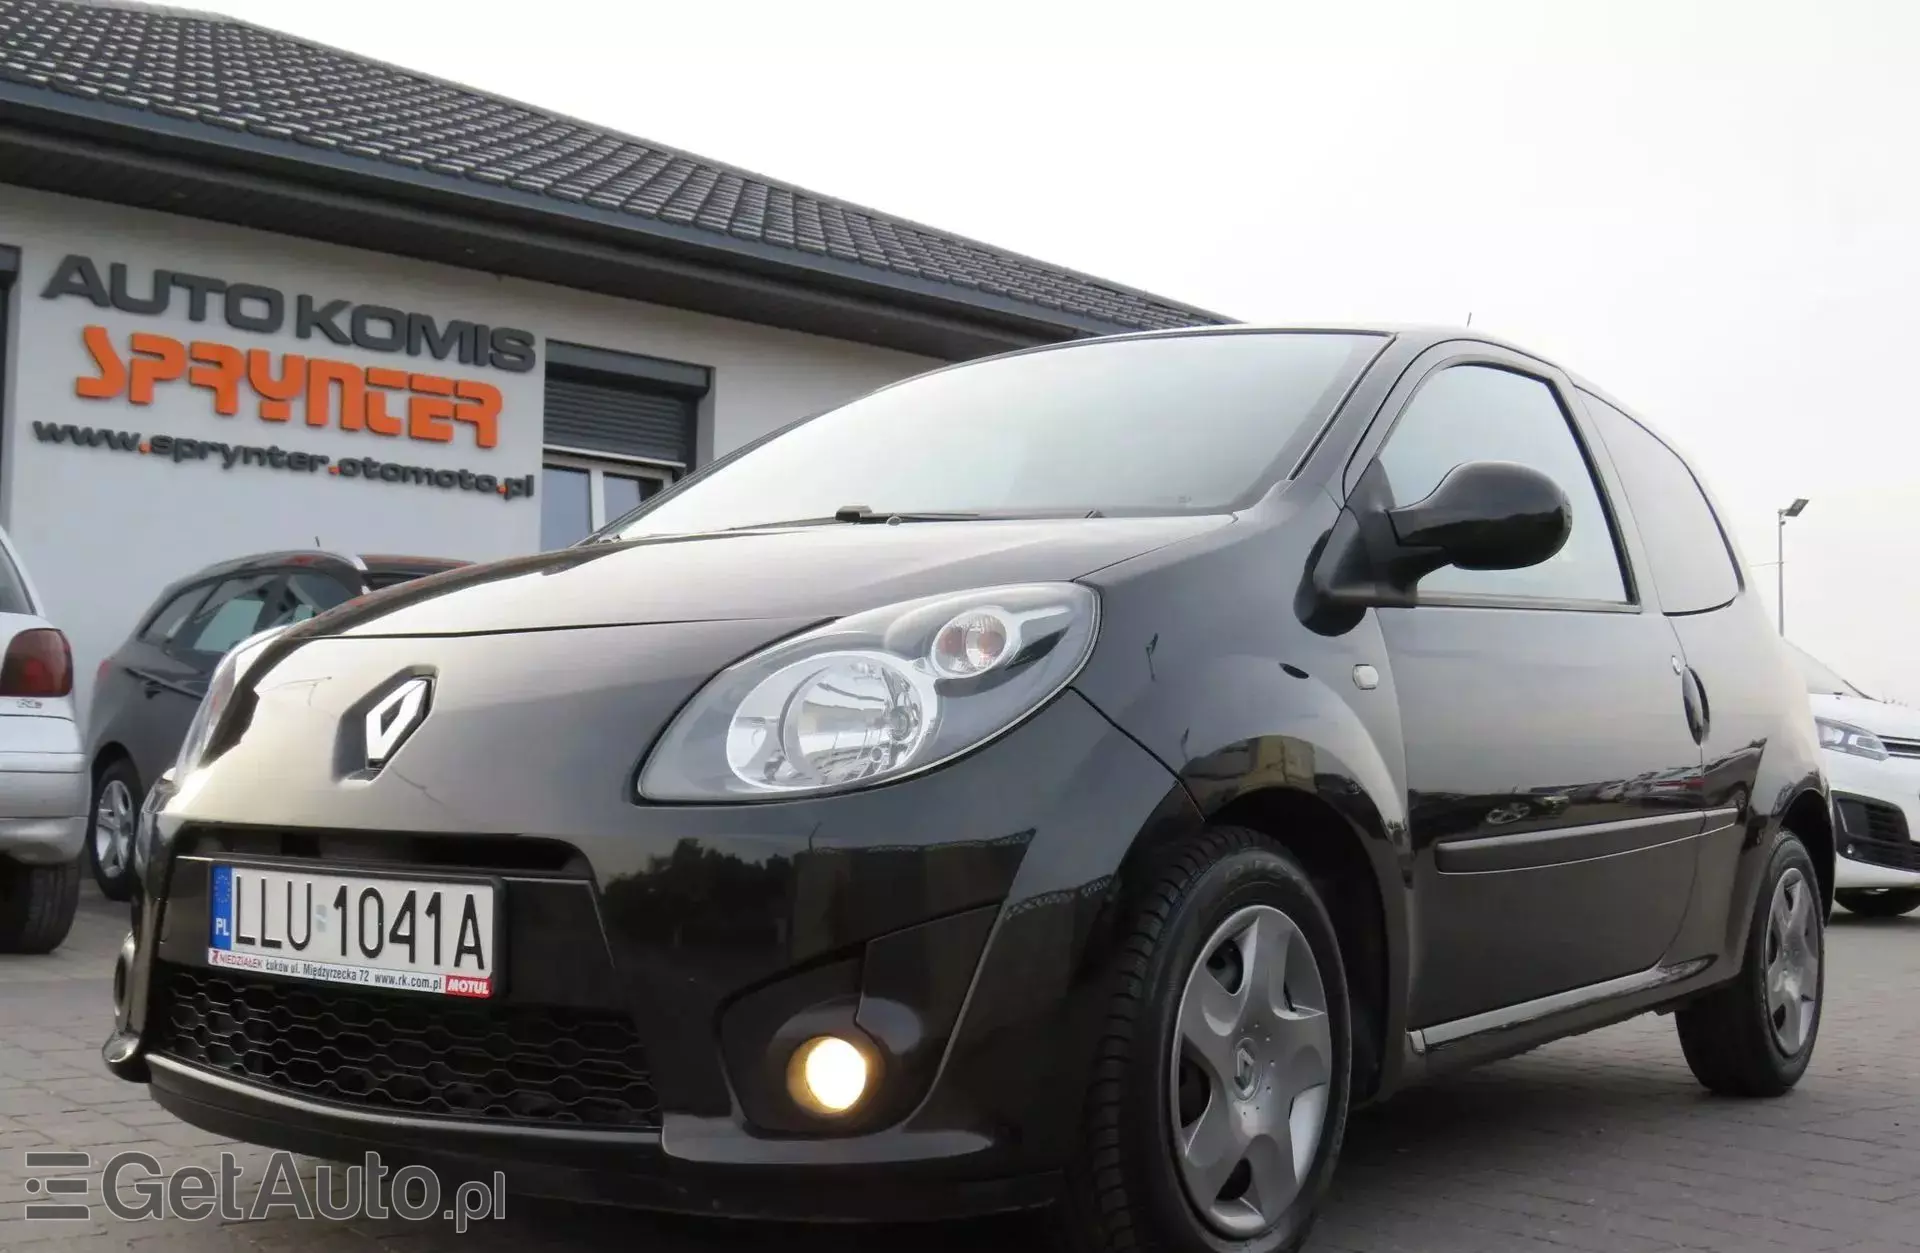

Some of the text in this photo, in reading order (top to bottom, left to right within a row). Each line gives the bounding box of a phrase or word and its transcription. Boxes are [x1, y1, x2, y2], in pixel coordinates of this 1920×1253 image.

[41, 254, 536, 373] AUTO KOMIS
[75, 325, 503, 449] SPRYNTER
[33, 420, 535, 500] www.sprynter.otomoto.pl
[215, 917, 229, 937] PL
[236, 875, 485, 970] LLU 1041A
[360, 969, 370, 983] 72
[374, 973, 442, 991] www.rk.com.pl
[447, 979, 490, 995] MOTUL
